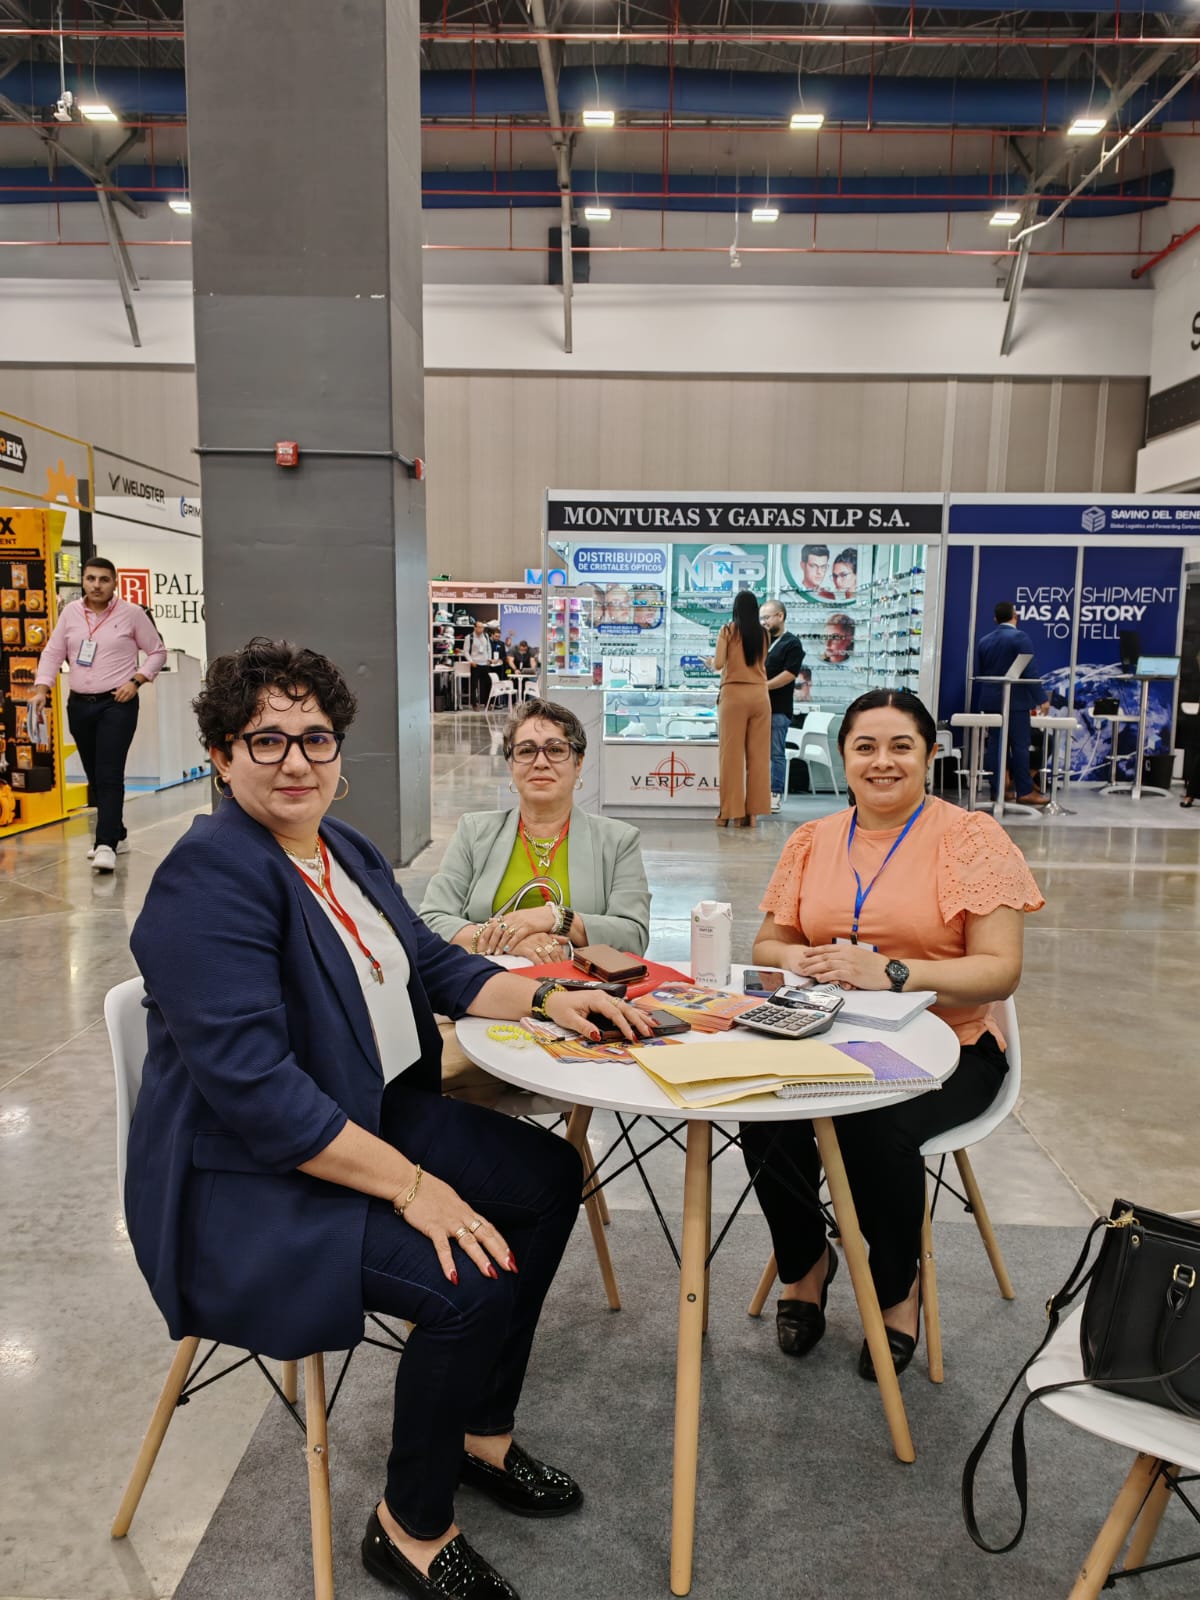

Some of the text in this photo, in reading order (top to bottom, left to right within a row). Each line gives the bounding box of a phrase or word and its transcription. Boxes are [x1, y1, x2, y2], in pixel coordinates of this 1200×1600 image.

[122, 478, 165, 504] WELDSTER
[563, 506, 911, 528] MONTURAS Y GAFAS NLP S.A.
[1111, 509, 1150, 520] SAVINO
[1152, 510, 1172, 520] DEL
[578, 551, 662, 563] DISTRIBUIDOR
[578, 562, 663, 572] DE CRISTALES ÓPTICOS
[1016, 586, 1177, 604] EVERY SHIPMENT
[155, 604, 180, 618] DEL
[503, 604, 542, 615] SPALDING
[1014, 605, 1147, 621] HAS A STORY
[1043, 623, 1121, 640] TO TELL
